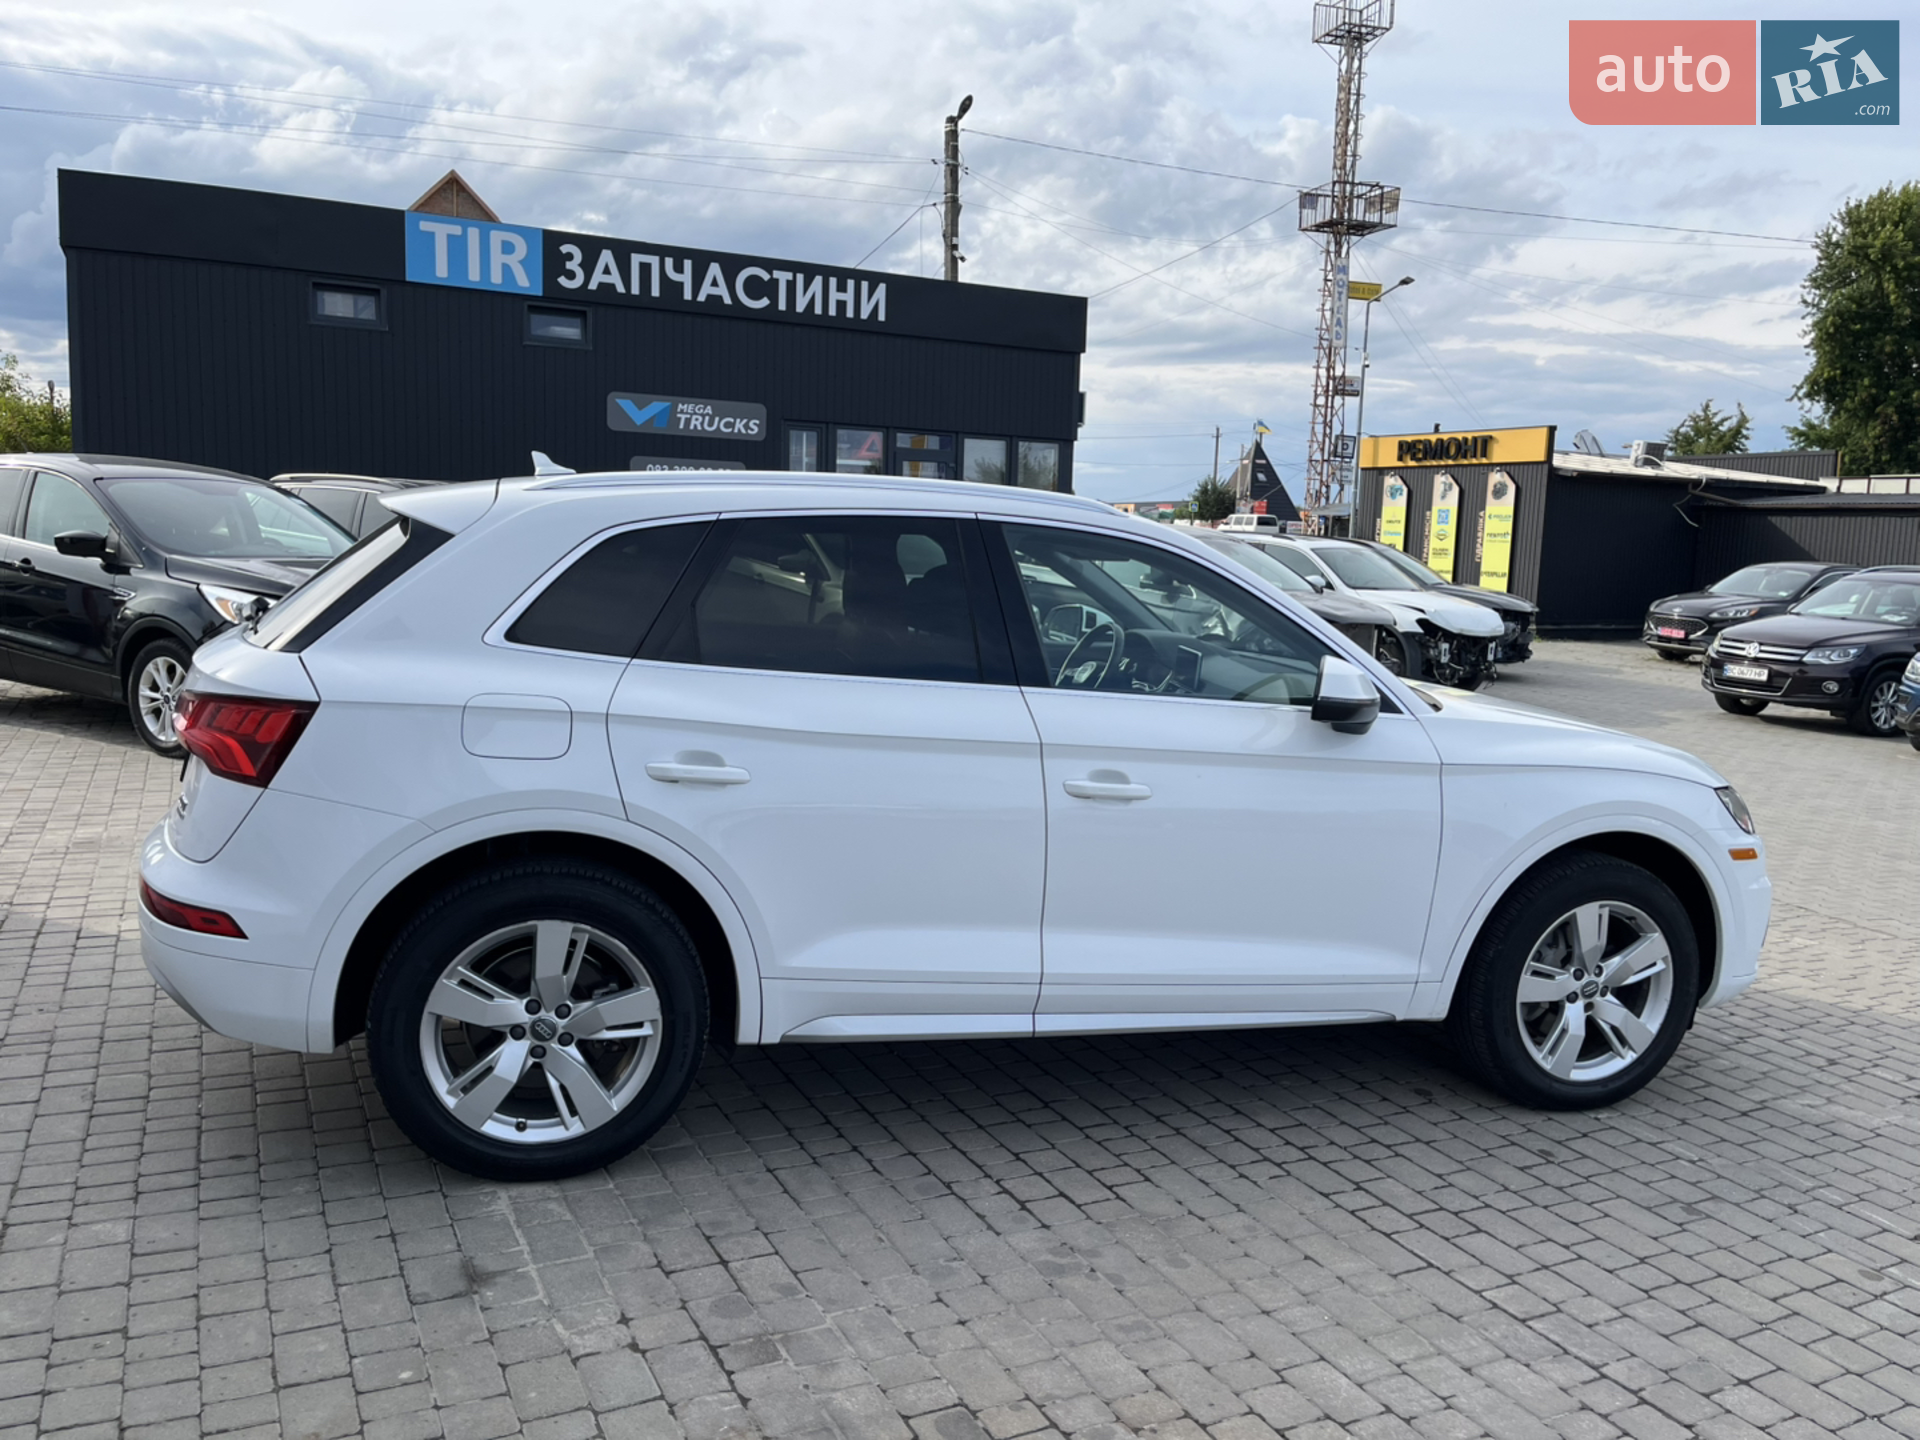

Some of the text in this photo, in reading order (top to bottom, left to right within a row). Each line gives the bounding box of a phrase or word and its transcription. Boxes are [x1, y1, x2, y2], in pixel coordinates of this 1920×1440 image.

[418, 220, 887, 322] TIR ЗАПЧАСТИНИ
[676, 403, 713, 415] MEGA
[676, 414, 761, 435] TRUCKS
[1397, 435, 1493, 462] РЕМОНТ
